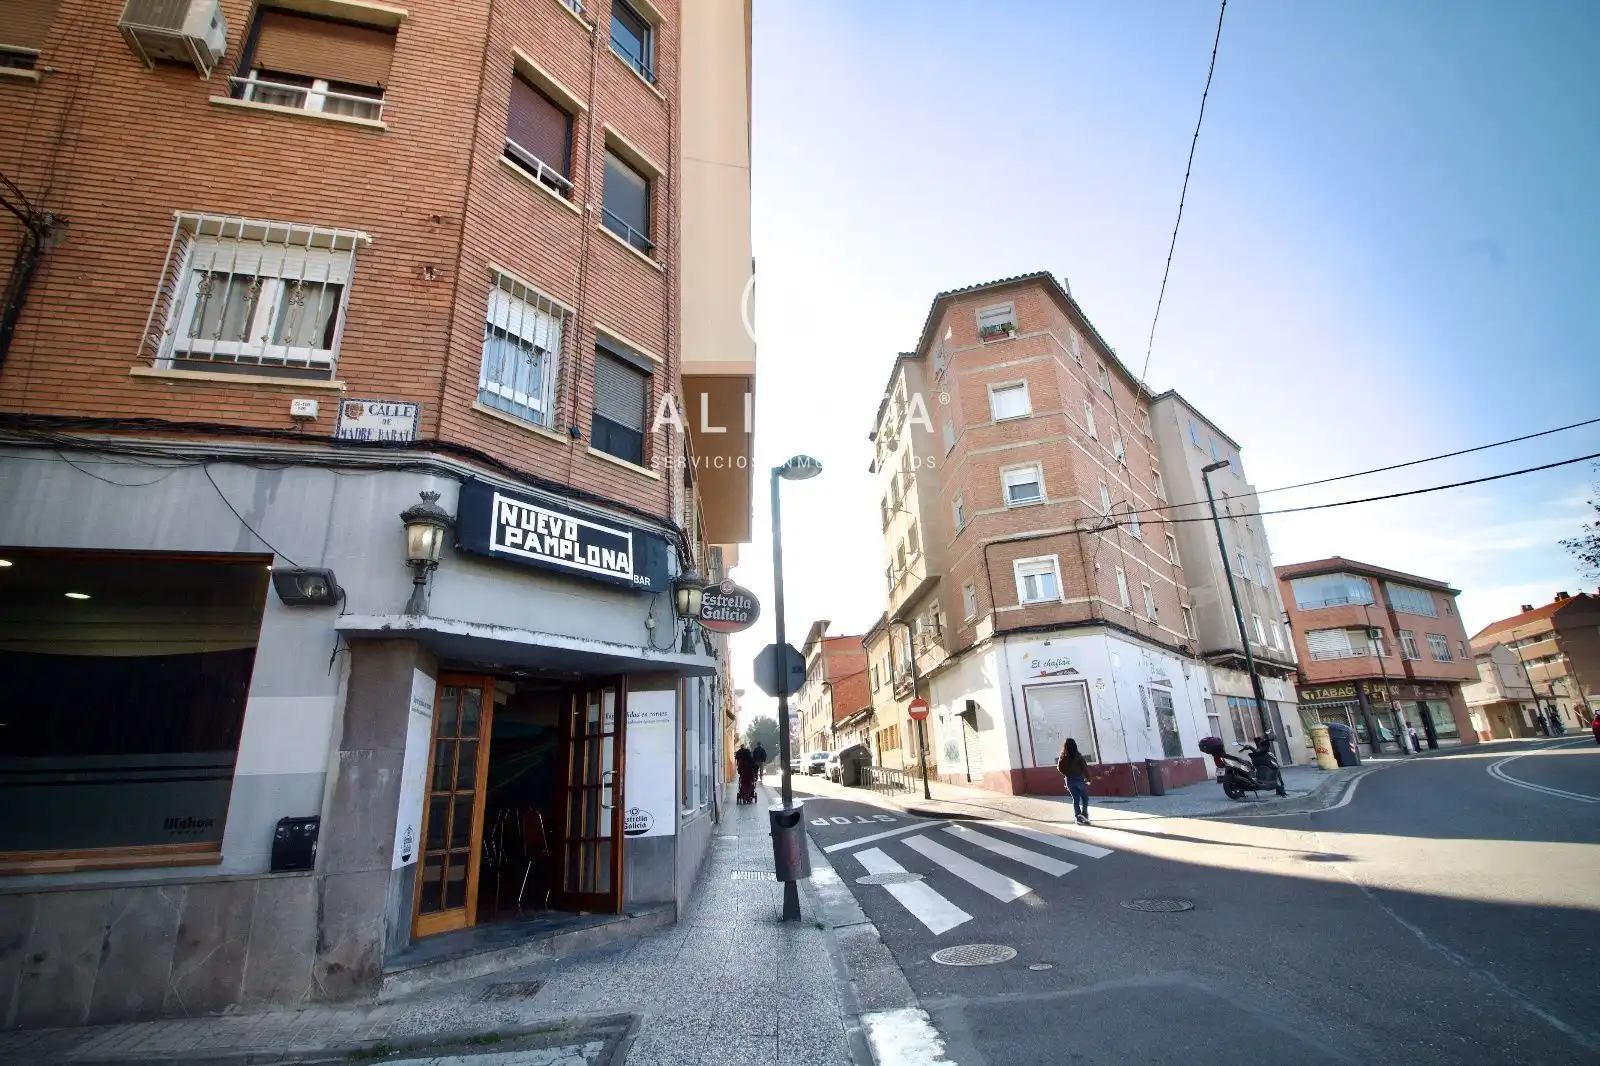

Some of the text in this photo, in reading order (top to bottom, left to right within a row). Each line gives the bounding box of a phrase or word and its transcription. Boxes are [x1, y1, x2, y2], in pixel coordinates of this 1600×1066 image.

[368, 403, 413, 417] CALLE
[382, 418, 392, 426] DE
[340, 427, 374, 441] MADRE
[500, 501, 578, 541] NUEVO
[504, 525, 630, 572] PAMPLONA
[633, 574, 651, 587] BAR
[701, 592, 752, 610] Estrella
[701, 605, 748, 622] Galicia
[810, 814, 897, 826] STOP
